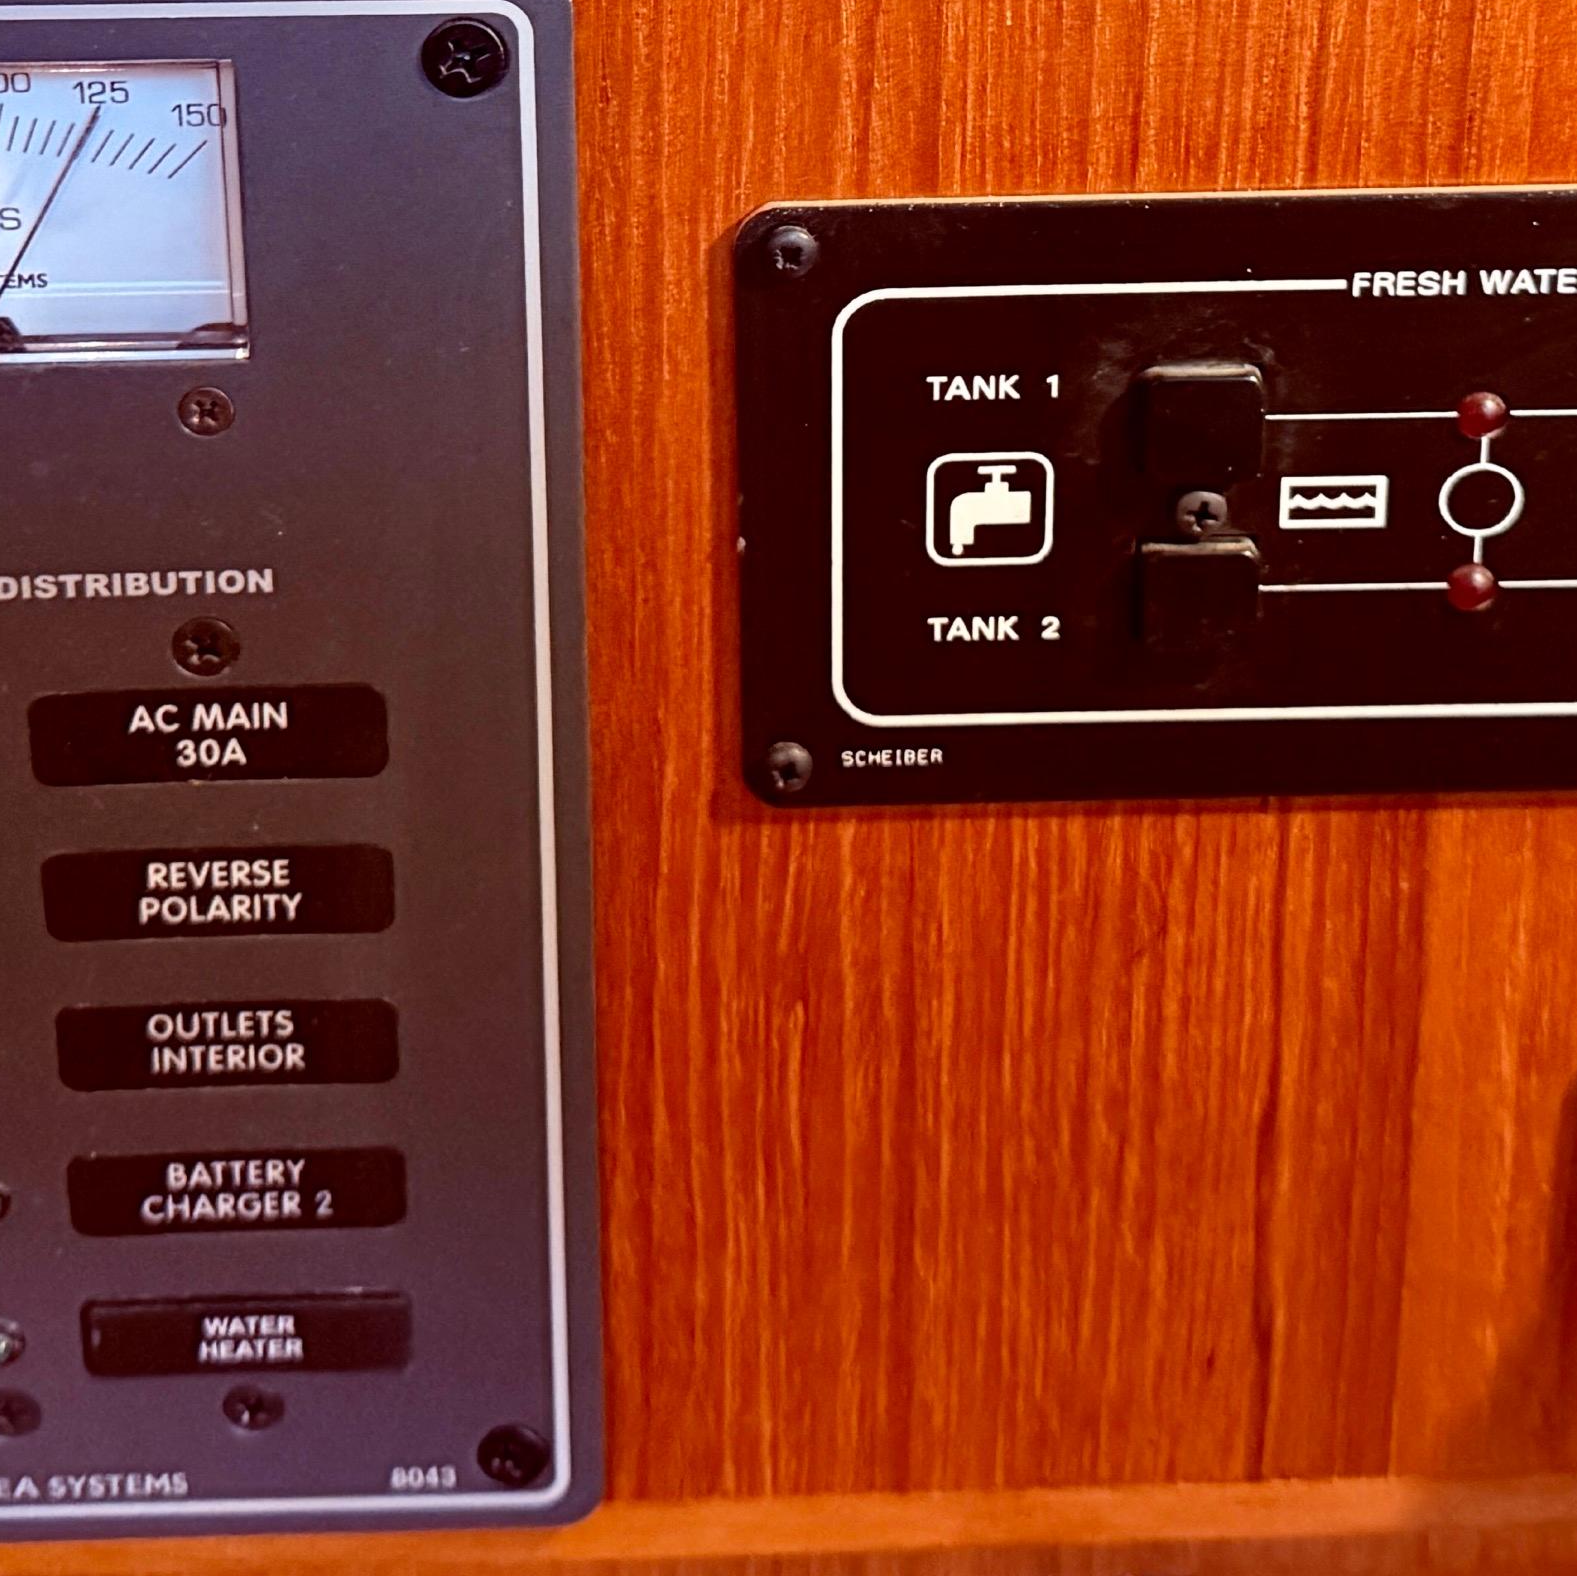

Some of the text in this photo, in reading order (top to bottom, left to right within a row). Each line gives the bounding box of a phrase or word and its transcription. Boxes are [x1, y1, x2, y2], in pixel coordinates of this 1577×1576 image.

[73, 80, 130, 105] 125
[172, 103, 227, 129] 150
[1352, 270, 1467, 298] FRESH
[925, 374, 1059, 401] TANK 1
[927, 615, 1060, 642] TANK 2
[129, 701, 288, 733] AC MAIN
[177, 737, 247, 767] 30A
[841, 748, 943, 767] SCHEIBER
[147, 859, 290, 889] REVERSE
[139, 892, 302, 923] POLARITY
[147, 1010, 294, 1040] OUTLETS
[152, 1043, 305, 1072] INTERIOR
[167, 1159, 305, 1189] BATTERY
[142, 1190, 333, 1221] CHARGER 2
[204, 1315, 295, 1337] WATER
[200, 1338, 303, 1360] HEATER
[49, 1472, 188, 1498] SYSTEMS
[391, 1466, 456, 1489] 8043
